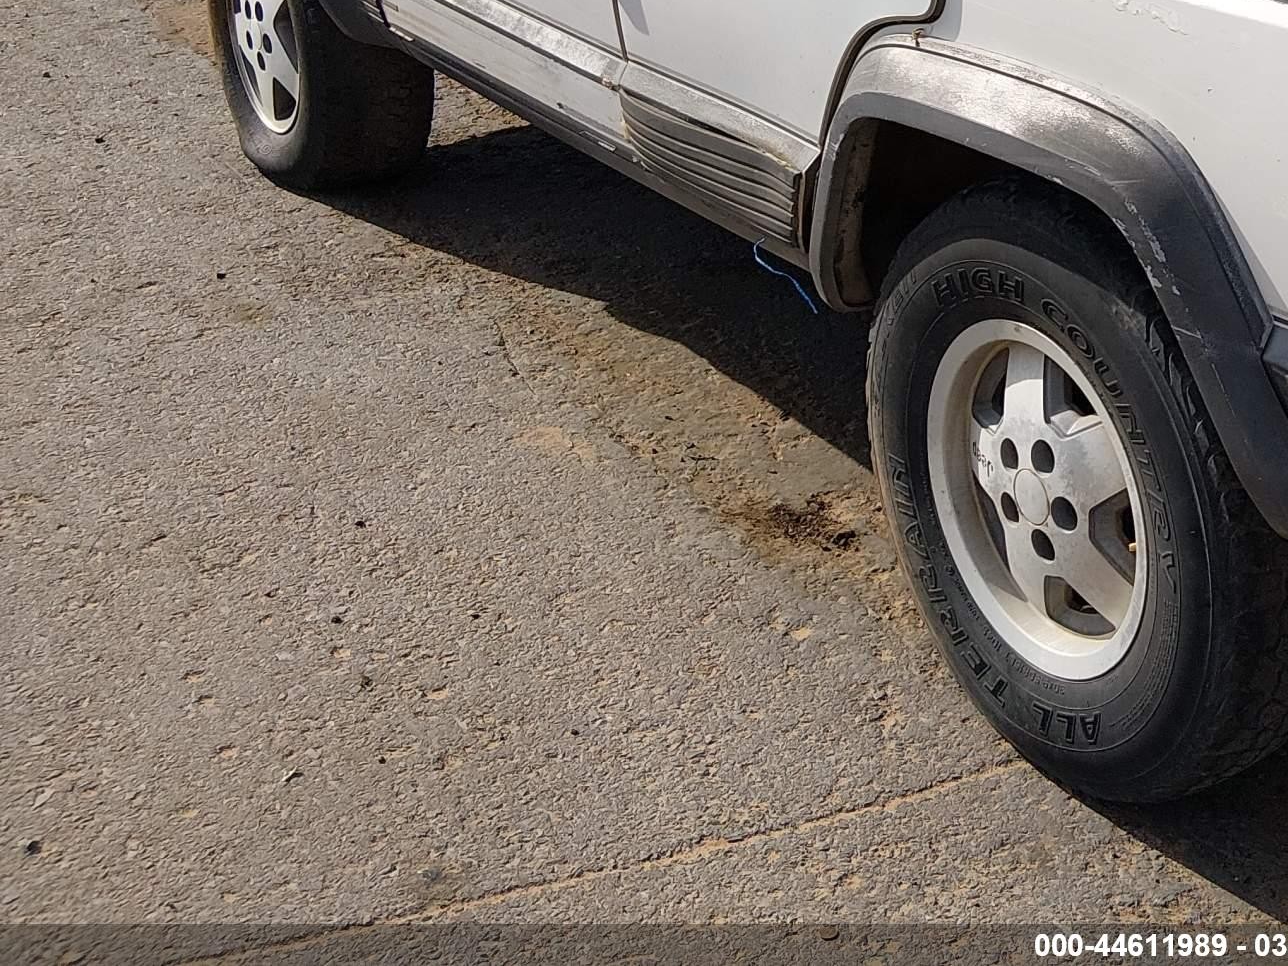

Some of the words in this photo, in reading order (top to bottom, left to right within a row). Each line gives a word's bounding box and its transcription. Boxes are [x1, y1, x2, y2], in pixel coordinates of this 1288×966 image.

[930, 265, 1026, 308] HIGH
[1040, 297, 1177, 595] COUNTRY
[888, 452, 1010, 709] TERRAIN
[1031, 701, 1102, 746] ALL
